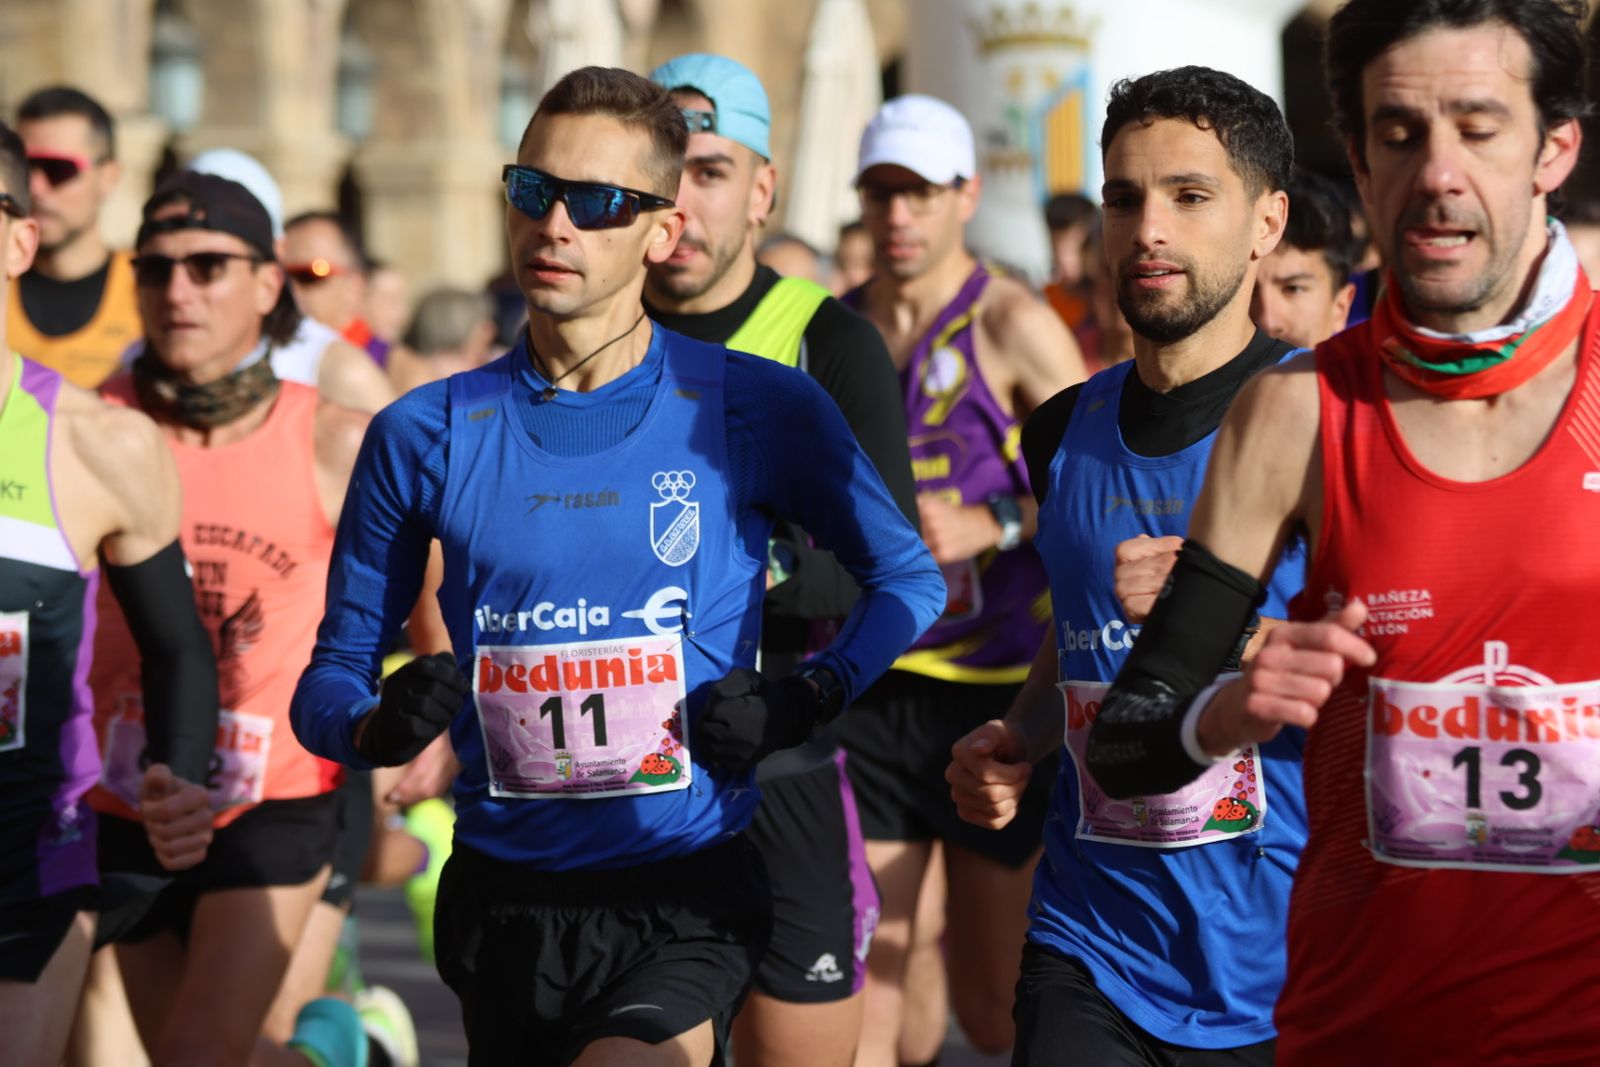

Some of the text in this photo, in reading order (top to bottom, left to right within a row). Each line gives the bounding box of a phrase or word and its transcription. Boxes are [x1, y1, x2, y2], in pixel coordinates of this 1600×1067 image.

[1366, 589, 1432, 605] BAÑEZA
[1370, 622, 1409, 636] LEÓN
[560, 645, 625, 659] FLORISTERÍAS
[479, 648, 678, 694] bedunia
[540, 694, 608, 750] 11
[574, 758, 626, 769] Ayuntamiento
[575, 767, 627, 779] de Salamanca
[1452, 746, 1543, 811] 13
[1160, 815, 1199, 825] Salamanca
